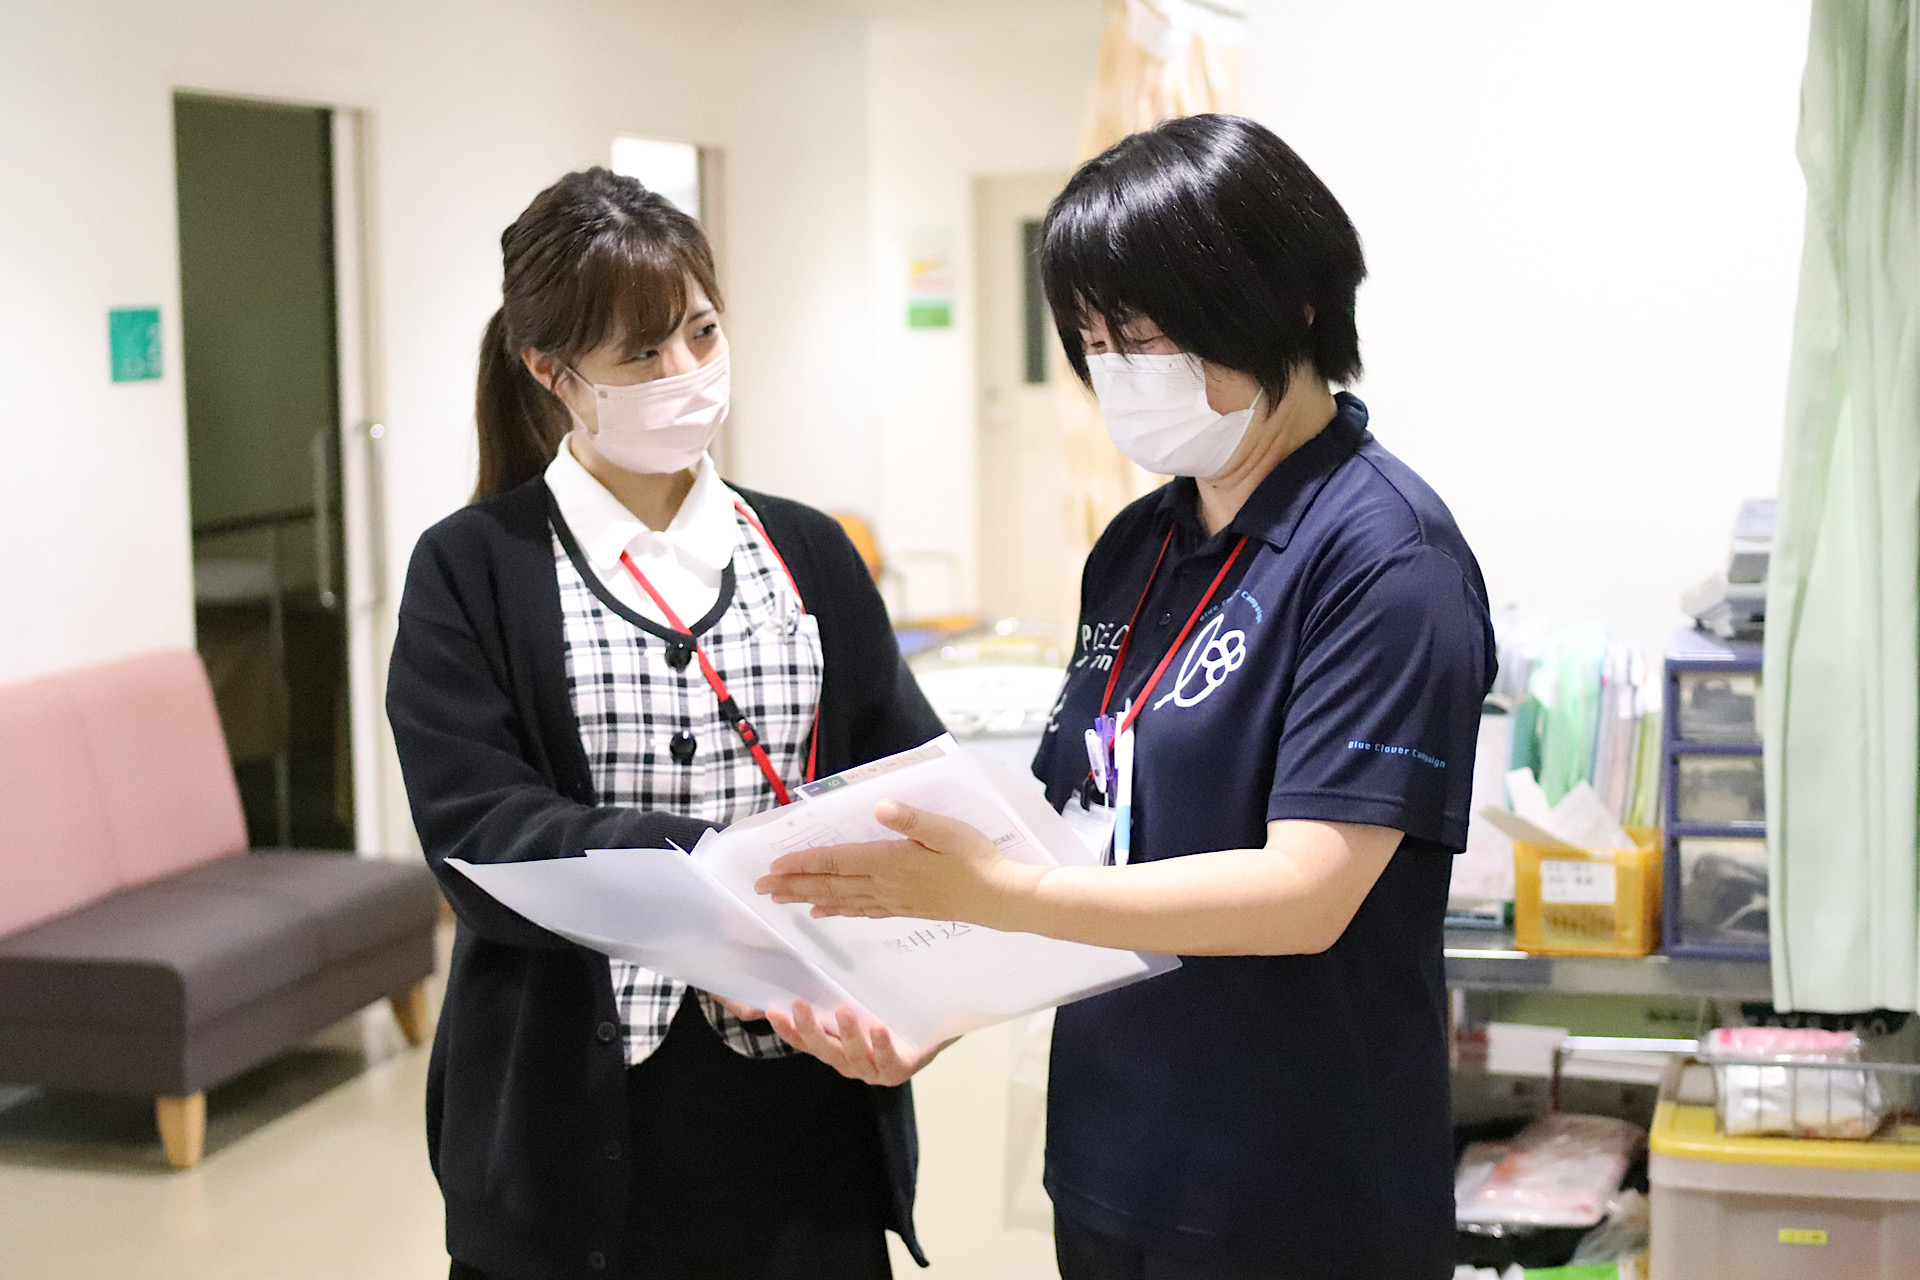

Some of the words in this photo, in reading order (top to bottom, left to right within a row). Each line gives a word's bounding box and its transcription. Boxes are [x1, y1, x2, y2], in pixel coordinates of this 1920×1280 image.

[1347, 740, 1372, 750] Blue
[1374, 743, 1410, 755] Clover
[1411, 748, 1446, 768] Campaign
